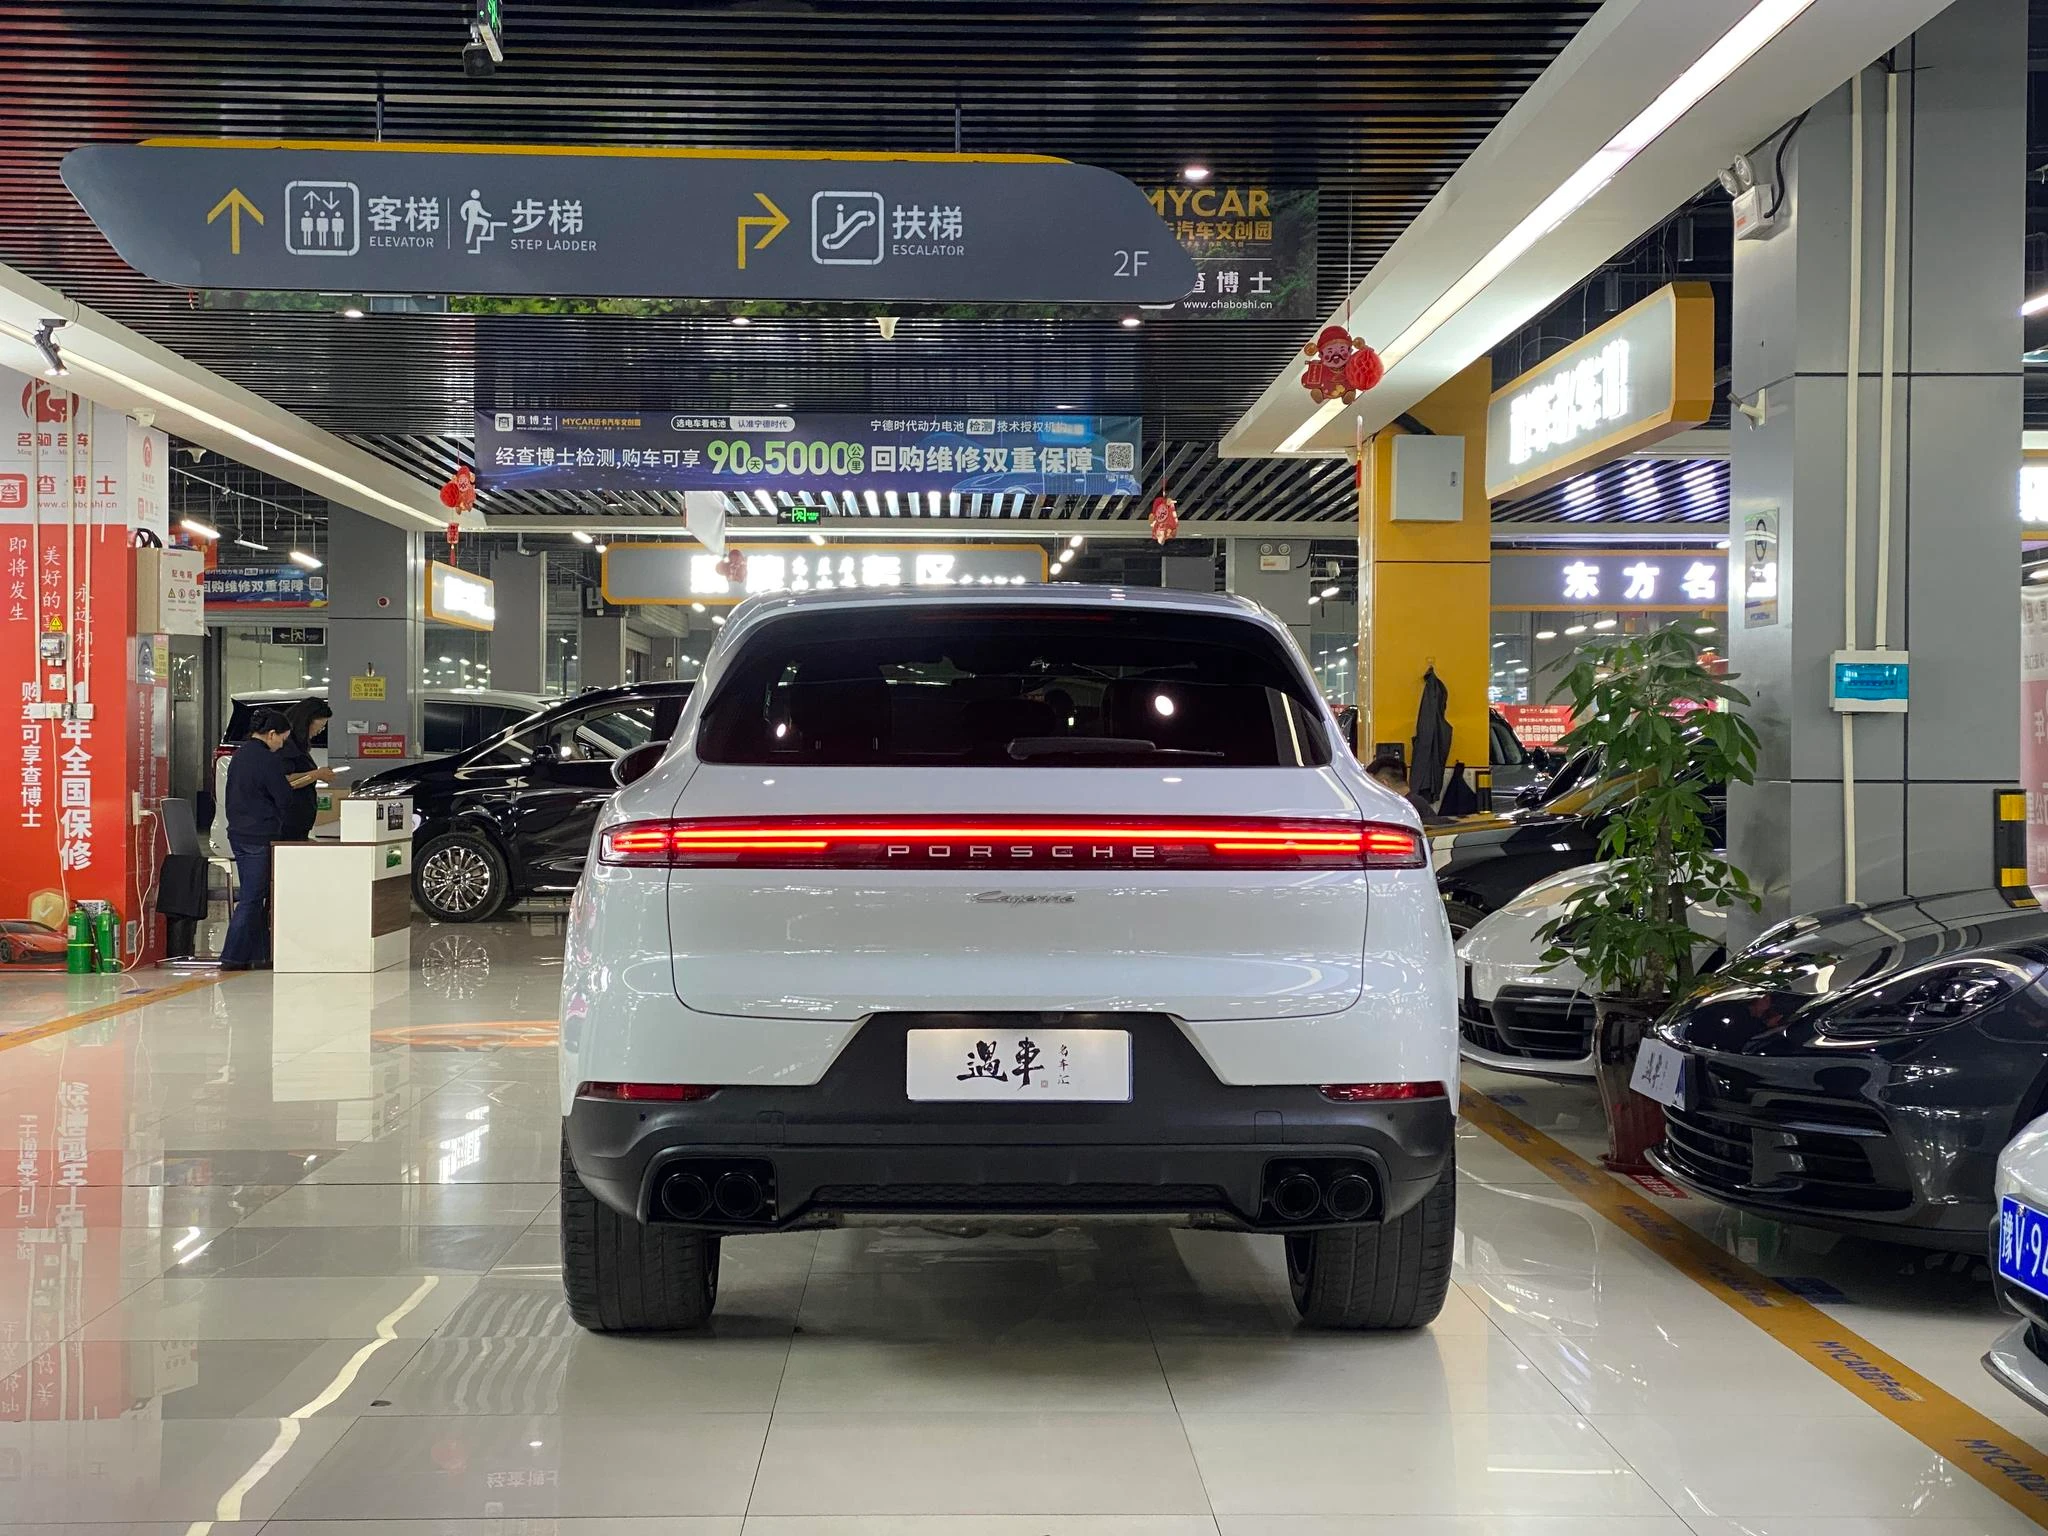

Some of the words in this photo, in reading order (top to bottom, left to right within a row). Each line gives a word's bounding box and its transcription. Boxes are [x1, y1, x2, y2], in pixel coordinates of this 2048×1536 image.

[368, 196, 440, 232] 客梯
[1141, 186, 1271, 217] MYCAR
[511, 199, 584, 235] 步梯
[892, 204, 964, 241] 扶梯
[369, 236, 434, 249] ELEVATOR
[510, 238, 542, 250] STEP
[546, 239, 598, 252] LADDER
[892, 244, 965, 257] ESCALATOR
[1113, 250, 1150, 277] 2F
[1183, 300, 1273, 311] www.chaboshi.cn
[870, 420, 965, 433] 宁德时代动力电池
[495, 446, 701, 469] 经查博士检测,购车可享
[870, 445, 1094, 473] 回购维修双重保障
[8, 536, 29, 622] 即将发生
[1563, 561, 1717, 599] 东方名
[887, 844, 1155, 858] PORSCHE
